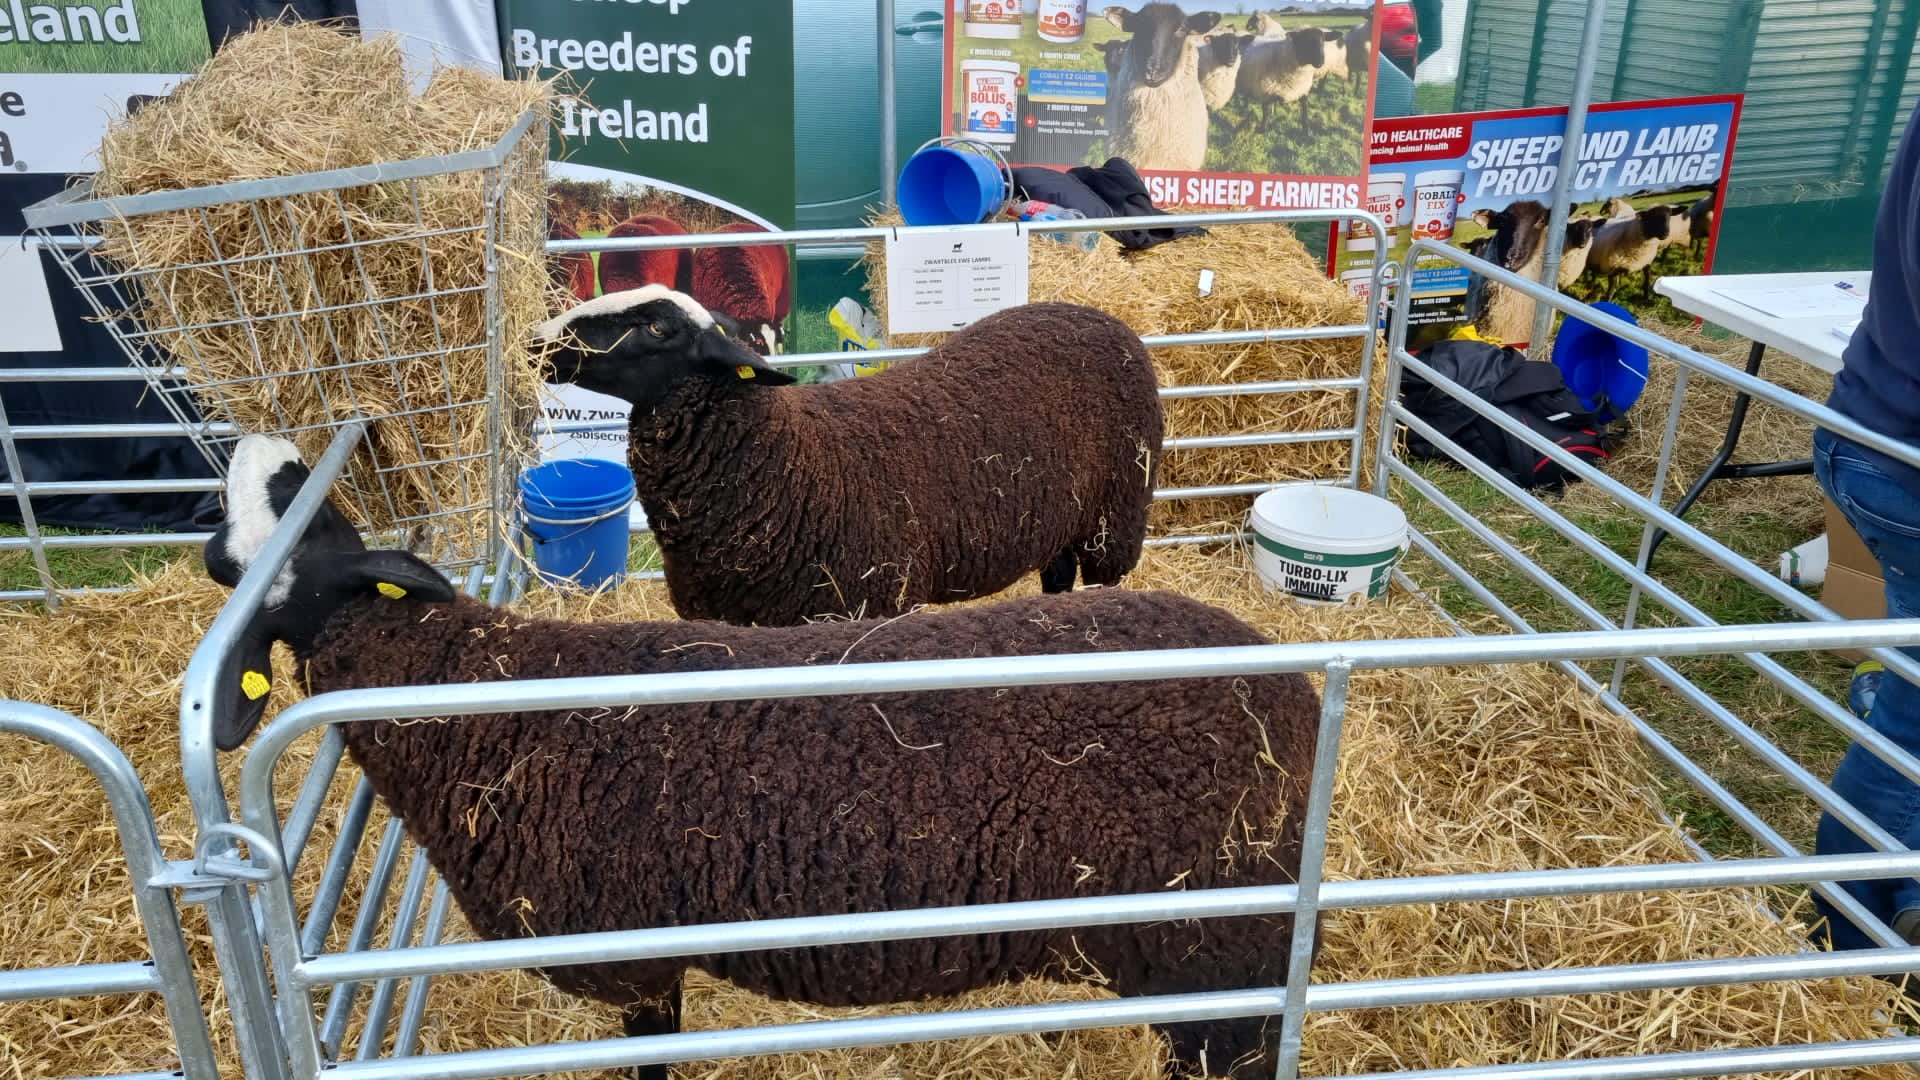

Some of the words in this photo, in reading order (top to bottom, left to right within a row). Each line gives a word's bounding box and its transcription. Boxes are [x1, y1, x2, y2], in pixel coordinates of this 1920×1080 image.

[512, 28, 699, 75] Breeders
[709, 35, 752, 76] of
[971, 92, 1006, 105] BOLUS
[560, 99, 708, 143] Ireland
[1391, 126, 1464, 143] HEALTHCARE
[1395, 143, 1422, 154] Animal
[1424, 142, 1449, 152] Health
[1467, 135, 1564, 169] SHEEP
[1633, 123, 1719, 157] LAMB
[1475, 160, 1616, 198] PRODCT
[1618, 152, 1721, 187] RANGE
[1140, 176, 1180, 204] ISH
[1186, 177, 1255, 206] SHEEP
[1260, 181, 1360, 208] FARMERS
[1418, 190, 1456, 201] COBALT
[1367, 203, 1391, 213] OLUS
[1426, 201, 1446, 210] FIX
[539, 407, 631, 420] ww.zwa
[1280, 559, 1348, 583] TURBO-LIX
[1285, 575, 1338, 596] IMMUNE
